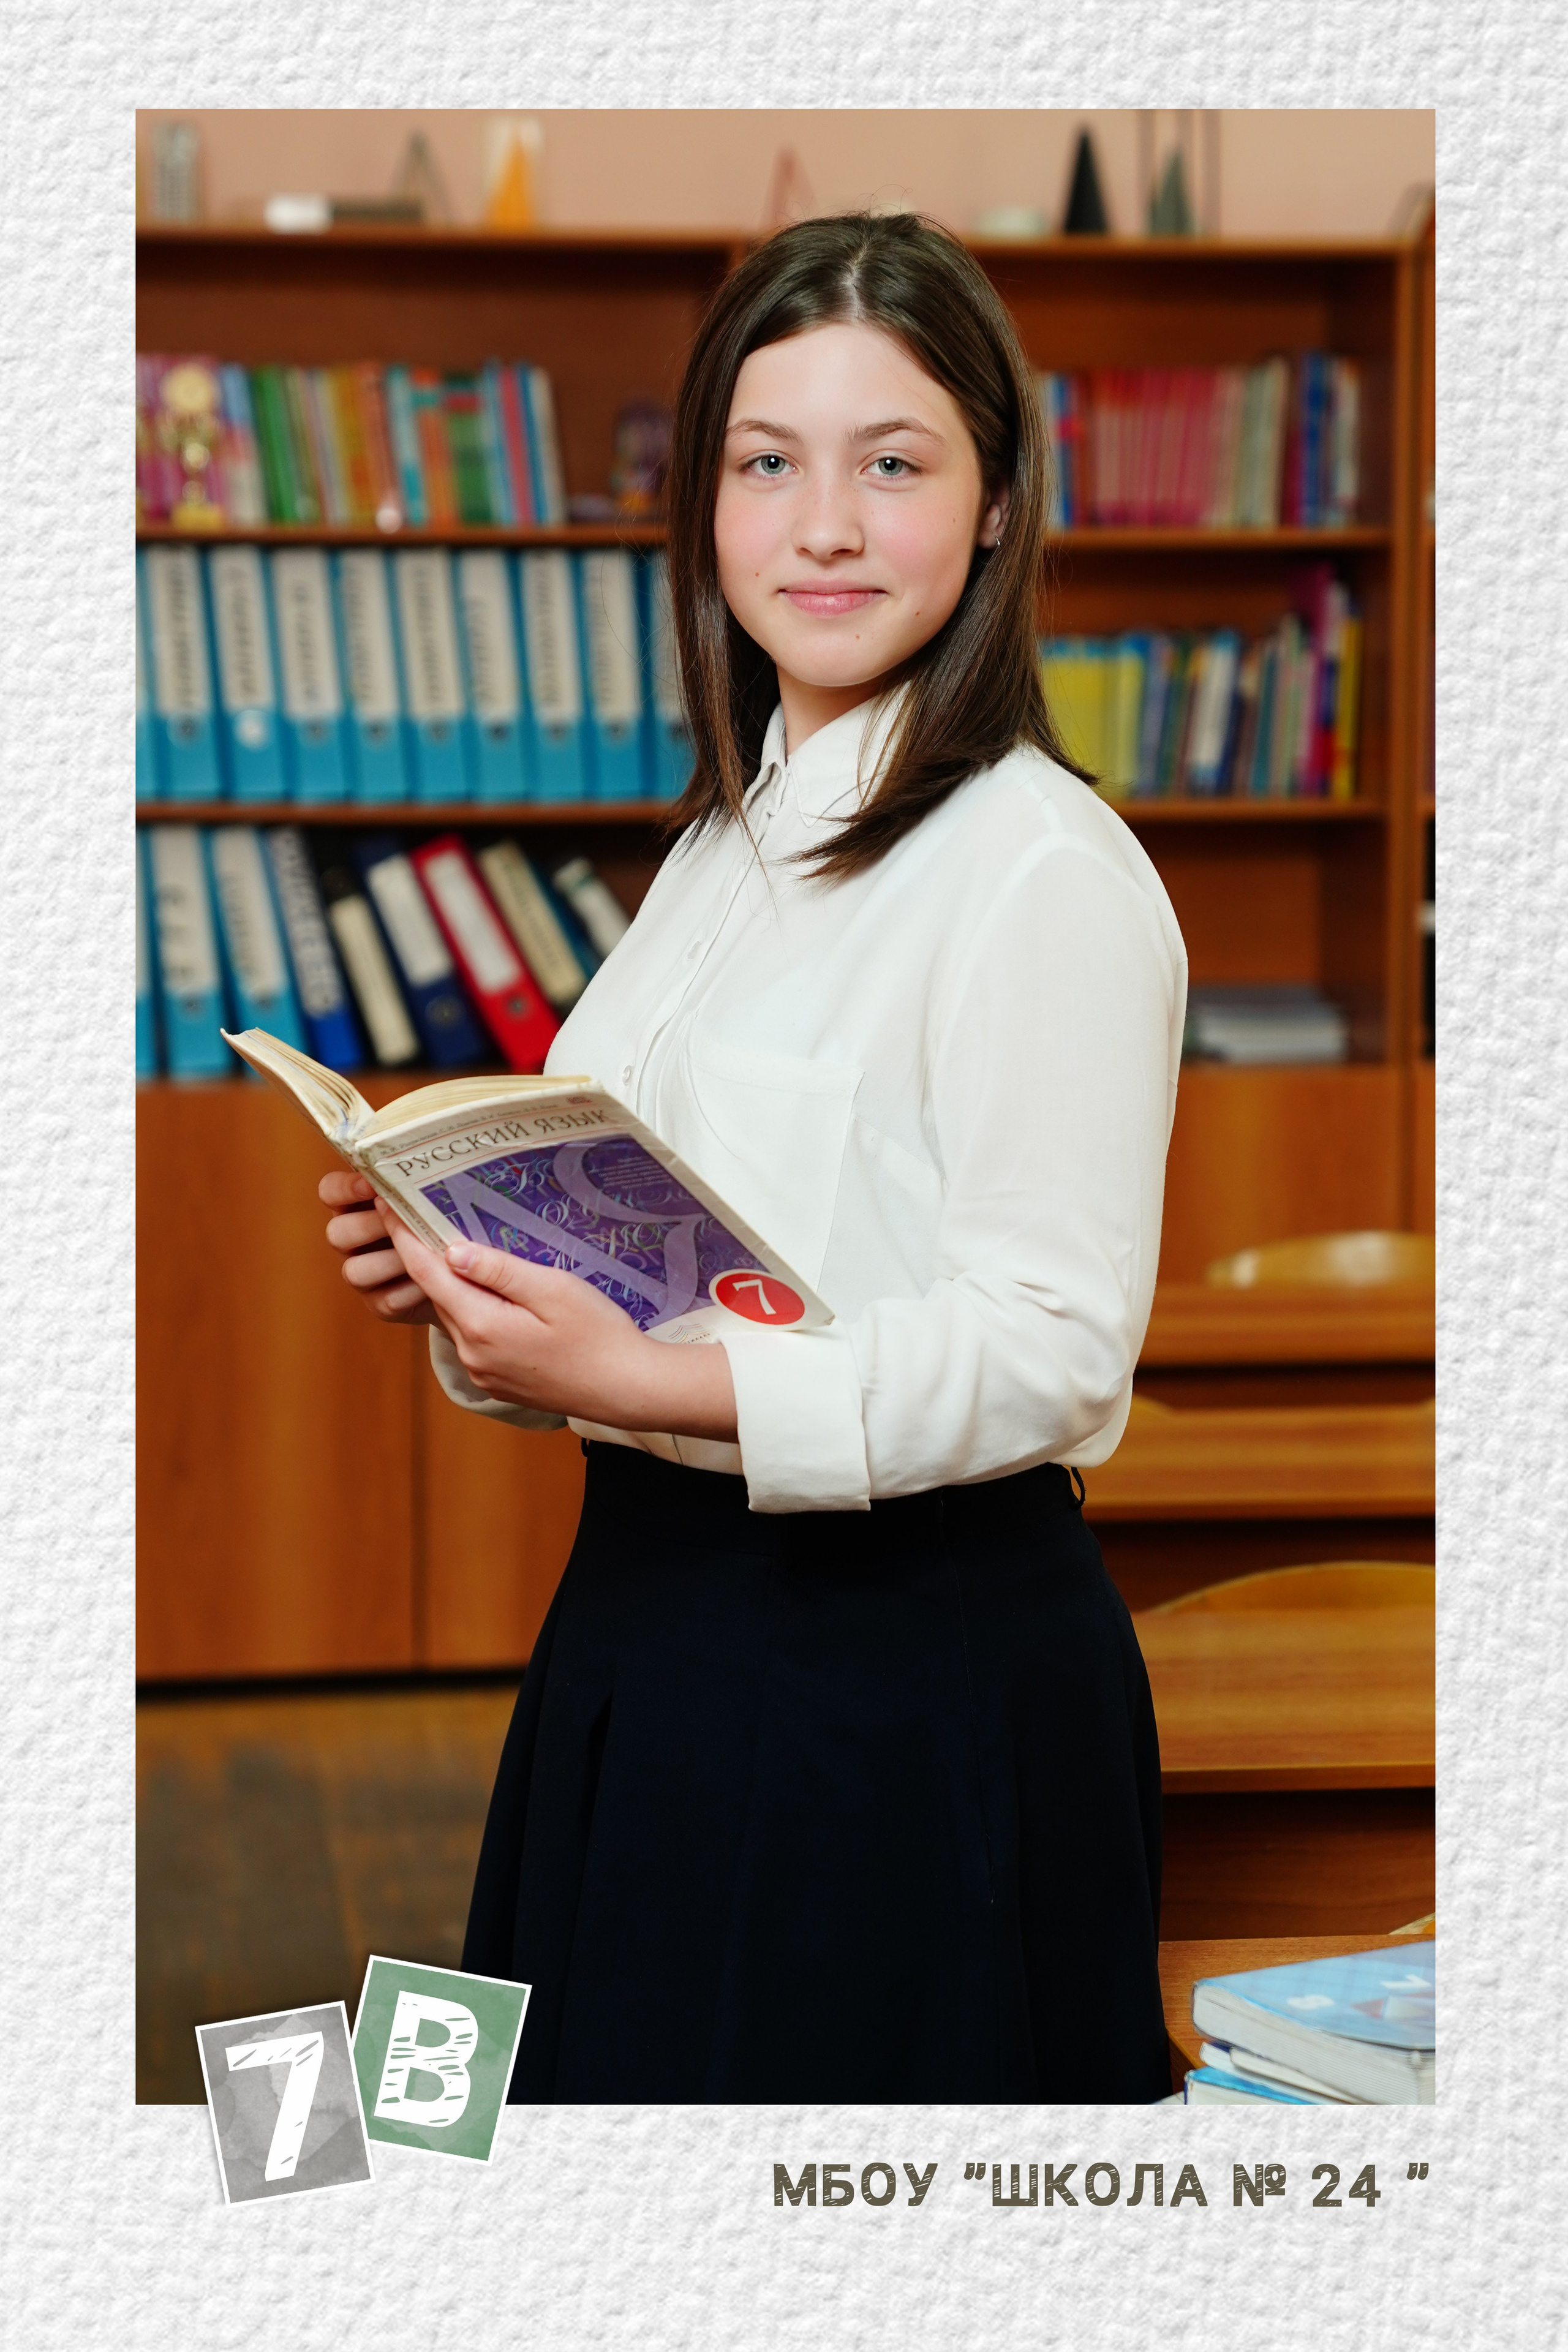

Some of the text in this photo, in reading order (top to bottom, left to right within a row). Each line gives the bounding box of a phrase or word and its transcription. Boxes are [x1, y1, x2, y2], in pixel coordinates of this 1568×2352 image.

[396, 1120, 530, 1177] РУССКИЙ
[534, 1109, 615, 1134] ЯЗЫК
[731, 1278, 777, 1316] 7
